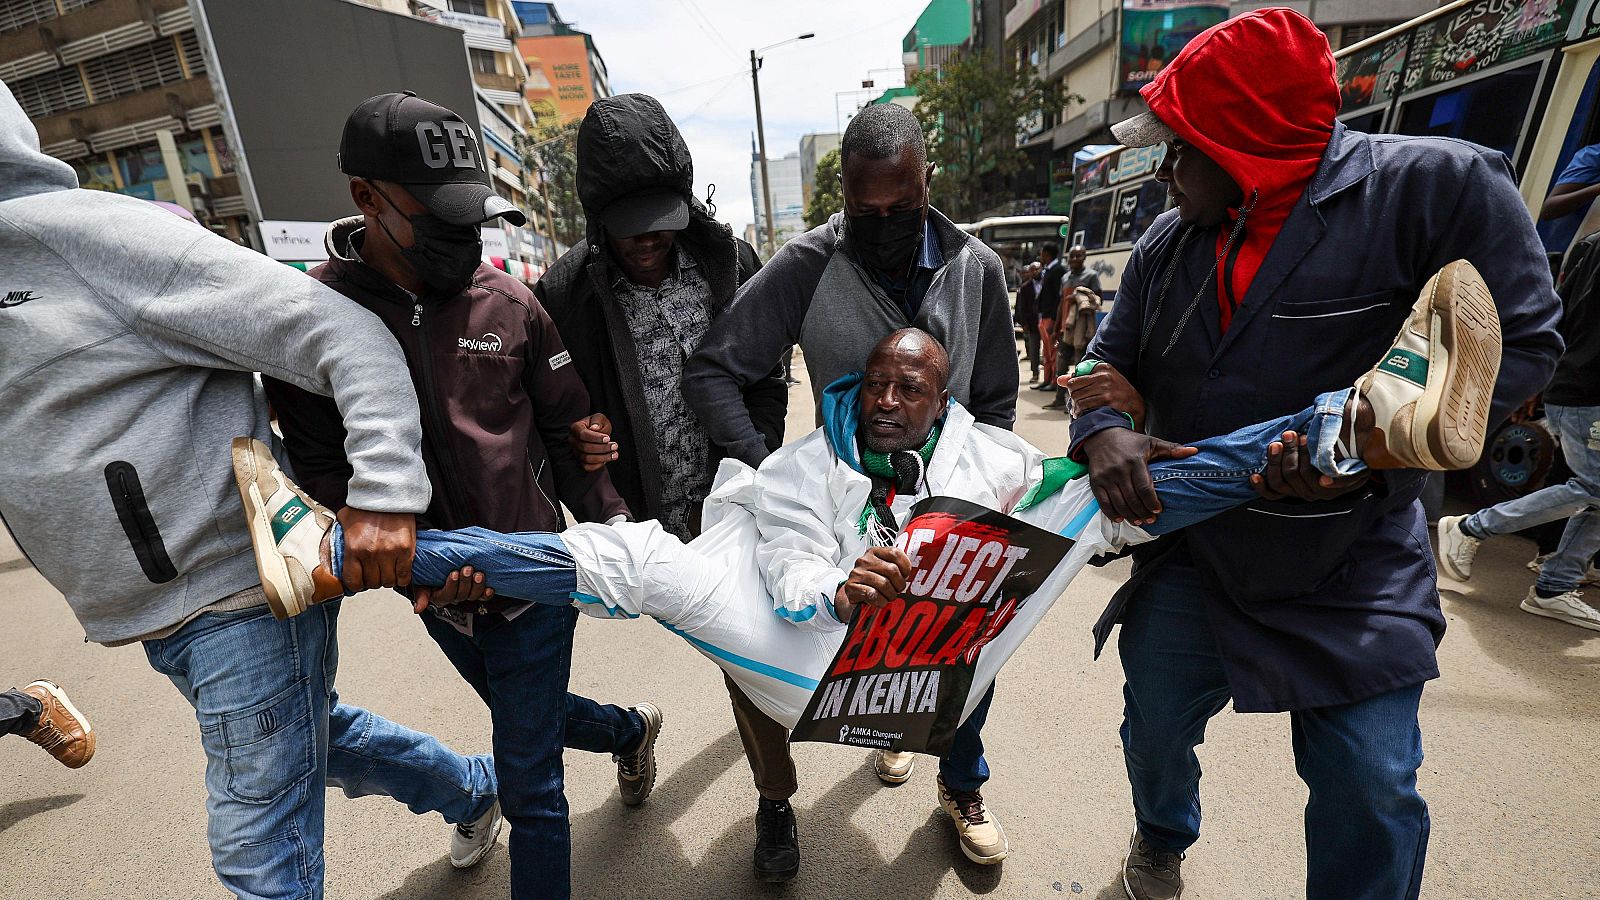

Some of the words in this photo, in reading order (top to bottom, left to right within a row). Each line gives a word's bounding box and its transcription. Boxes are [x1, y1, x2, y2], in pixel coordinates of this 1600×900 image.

[1444, 0, 1515, 40] JESUS
[1475, 46, 1501, 71] YOU
[5, 290, 34, 301] NIKE
[831, 597, 988, 677] EBOLA
[812, 677, 852, 721] IN
[848, 670, 941, 716] KENYA
[851, 727, 871, 736] AMKA
